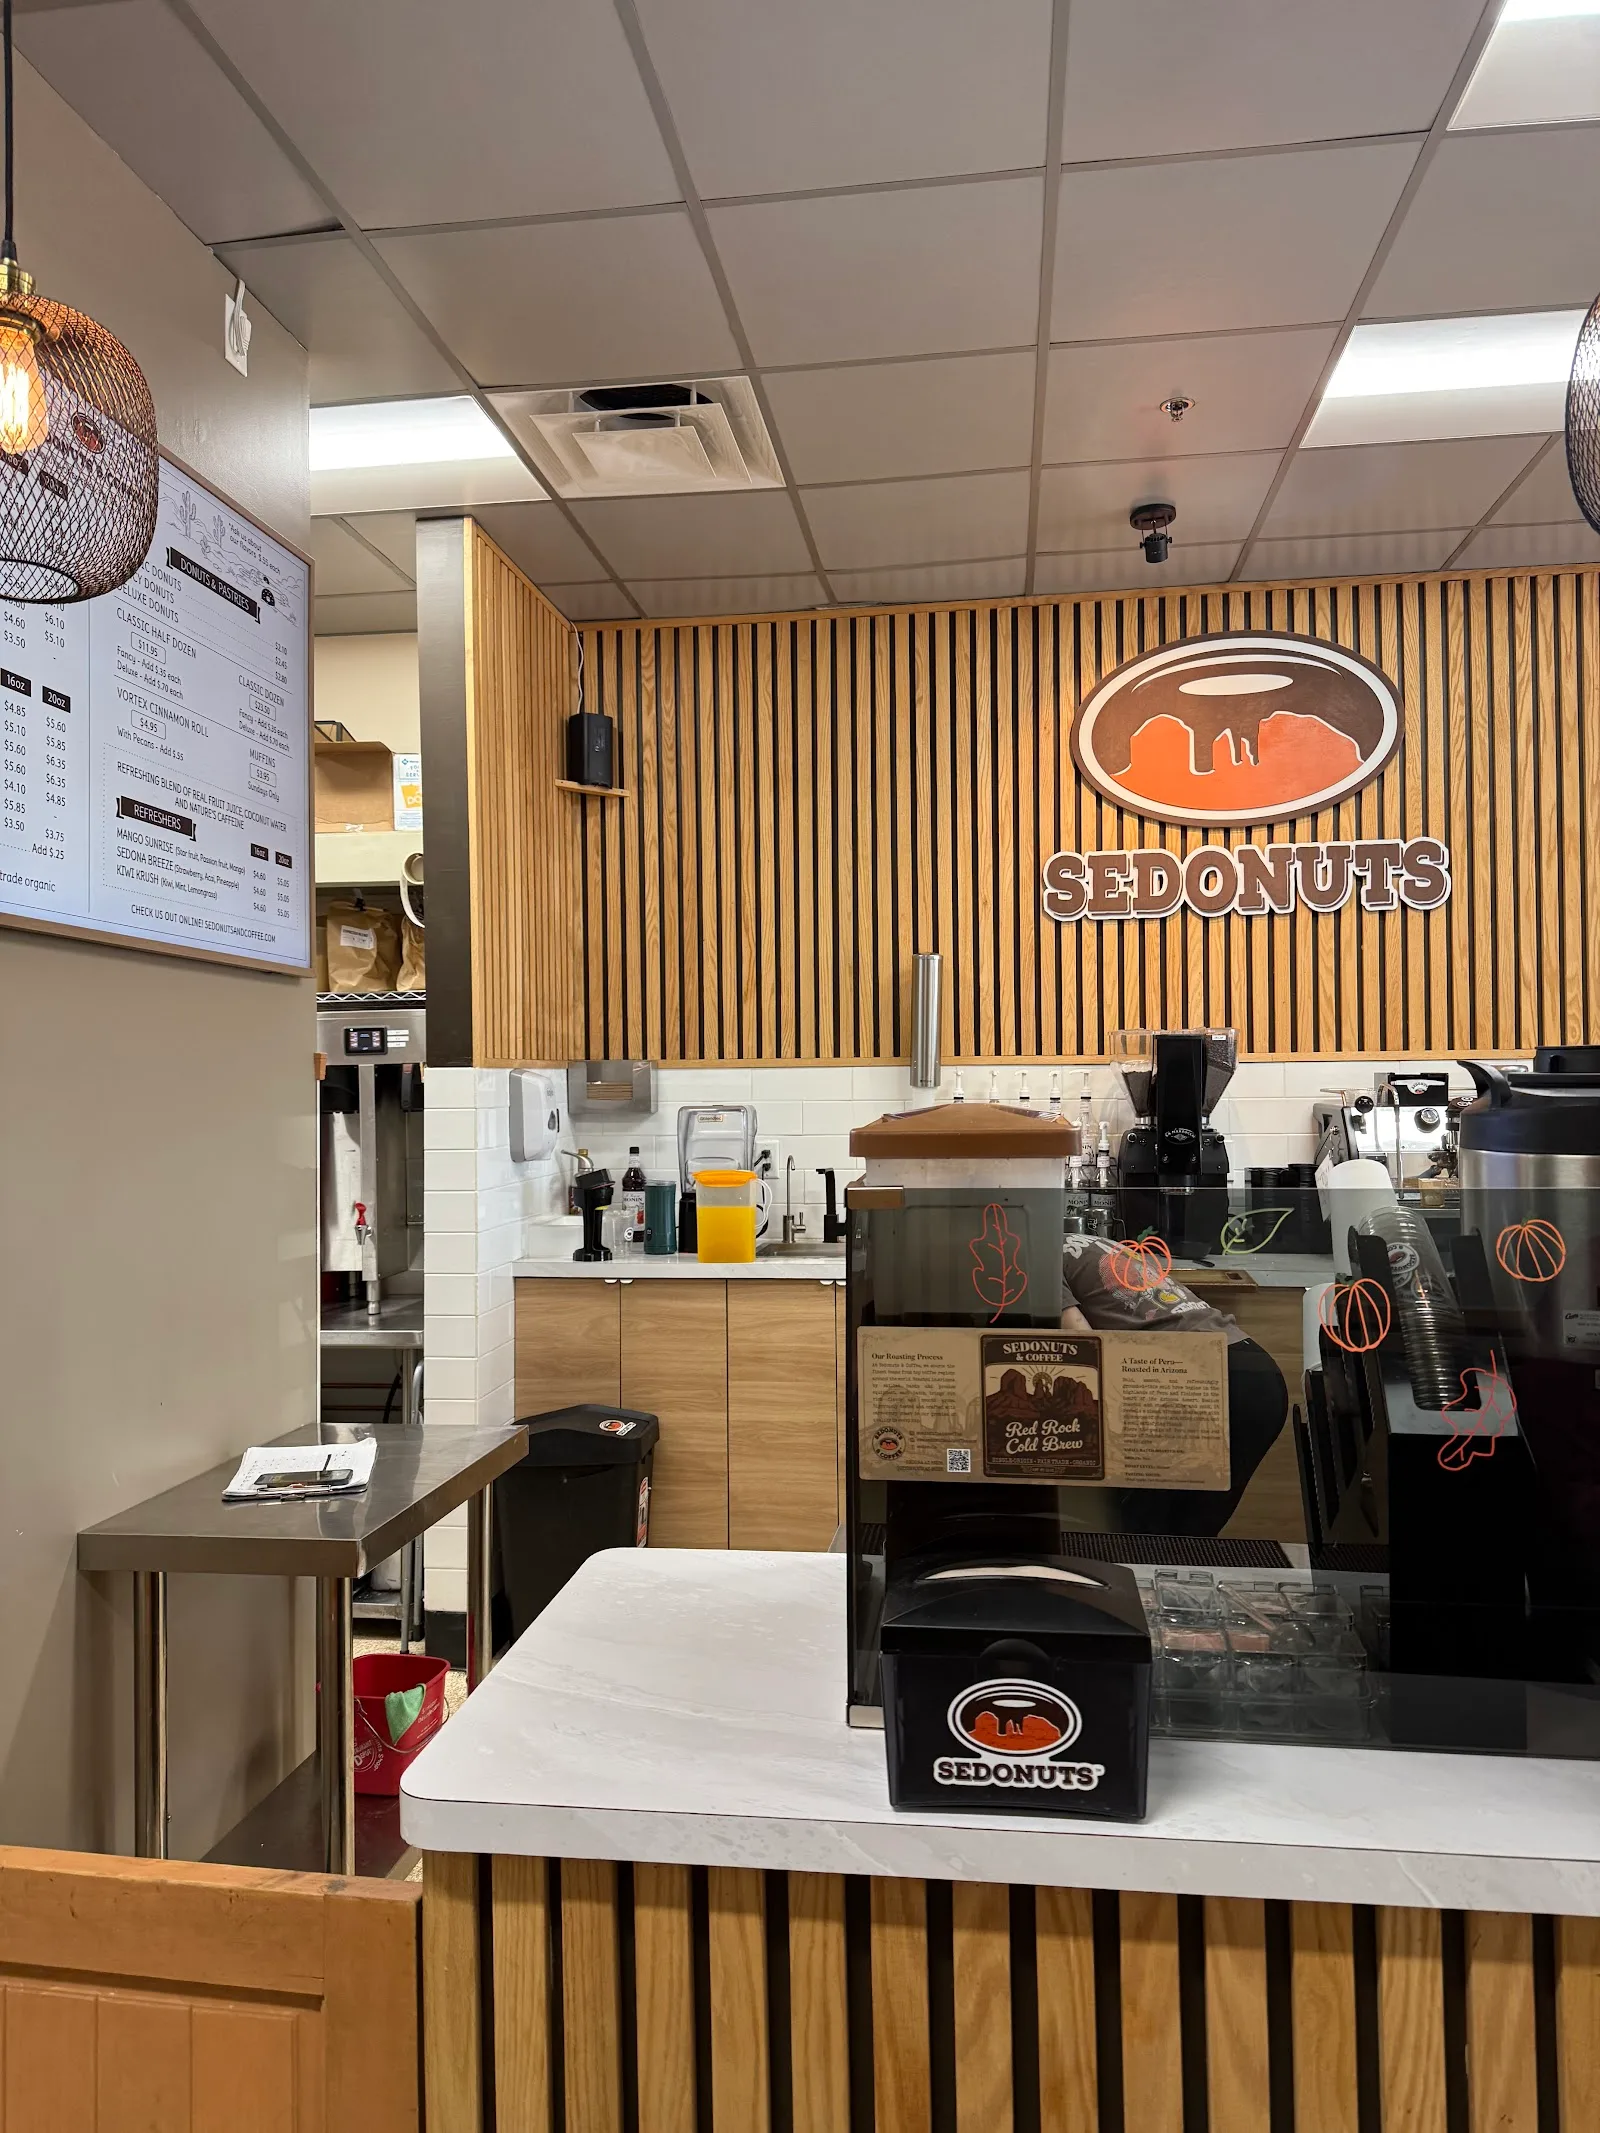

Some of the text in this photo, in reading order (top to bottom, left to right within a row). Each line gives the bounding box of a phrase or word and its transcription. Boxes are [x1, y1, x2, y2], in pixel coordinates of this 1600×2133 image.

[151, 565, 182, 591] DONUTS
[180, 557, 211, 586] DONUTS
[210, 578, 217, 591] &
[218, 582, 250, 610] PASTRIES
[144, 577, 175, 604] DONUTS
[148, 597, 179, 623] DONUTS
[4, 611, 26, 629] $4.60
[44, 611, 65, 630] $6.10
[4, 630, 26, 649] $3.50
[44, 630, 65, 648] $5.10
[116, 607, 197, 659] CLASSIC HALF DOZEN
[138, 639, 158, 657] $11.95
[117, 645, 136, 665] Fancy
[141, 658, 154, 672] Add
[167, 673, 182, 686] each
[7, 674, 26, 691] 16oz
[117, 660, 139, 678] Deluxe
[143, 673, 156, 687] Add
[169, 688, 184, 700] each
[47, 691, 66, 708] 20oz
[238, 674, 284, 707] CLASSIC DOZEN
[4, 700, 26, 717] $4.85
[117, 686, 209, 738] VORTEX CINNAMON ROLL
[4, 720, 26, 737] $5.10
[46, 716, 66, 733] $5.60
[140, 717, 158, 733] $4.95
[4, 739, 26, 756] $5.60
[46, 735, 66, 752] $5.85
[117, 725, 132, 740] With
[132, 732, 155, 750] Pecans
[159, 744, 172, 757] Add
[4, 758, 26, 775] $5.60
[46, 754, 66, 770] $6.35
[249, 747, 276, 768] MUFFINS
[4, 778, 26, 795] $4.10
[46, 773, 66, 789] $6.35
[117, 761, 160, 786] REFRESHING
[160, 777, 182, 794] BLEND
[182, 785, 191, 797] OF
[192, 789, 208, 804] REAL
[208, 795, 225, 810] FRUIT
[4, 797, 26, 814] $5.85
[46, 792, 66, 807] $4.85
[175, 797, 189, 810] AND
[4, 816, 25, 832] $3.50
[133, 804, 182, 830] REFRESHERS
[45, 828, 65, 842] $3.75
[116, 827, 144, 845] MANGO
[144, 835, 174, 853] SUNRISE
[32, 843, 48, 856] Add
[116, 845, 147, 864] SEDONA
[147, 854, 174, 871] BREEZE
[116, 864, 135, 879] KIWI
[135, 869, 159, 885] KRUSH
[1042, 836, 1452, 922] SEDONUTS
[24, 878, 56, 892] organic
[131, 904, 276, 943] CHECK US OUT ONLINE! SEDONUTSANDCOFFEE.COM
[871, 1352, 944, 1361] Our Roasting Process
[1002, 1340, 1079, 1356] SEDONUTS
[1016, 1353, 1064, 1362] & COFFEE
[1121, 1357, 1128, 1365] A
[1128, 1357, 1148, 1365] Taste
[1121, 1366, 1151, 1374] Roasted
[1005, 1418, 1081, 1438] Red Rock
[1005, 1435, 1083, 1454] Cold Brew
